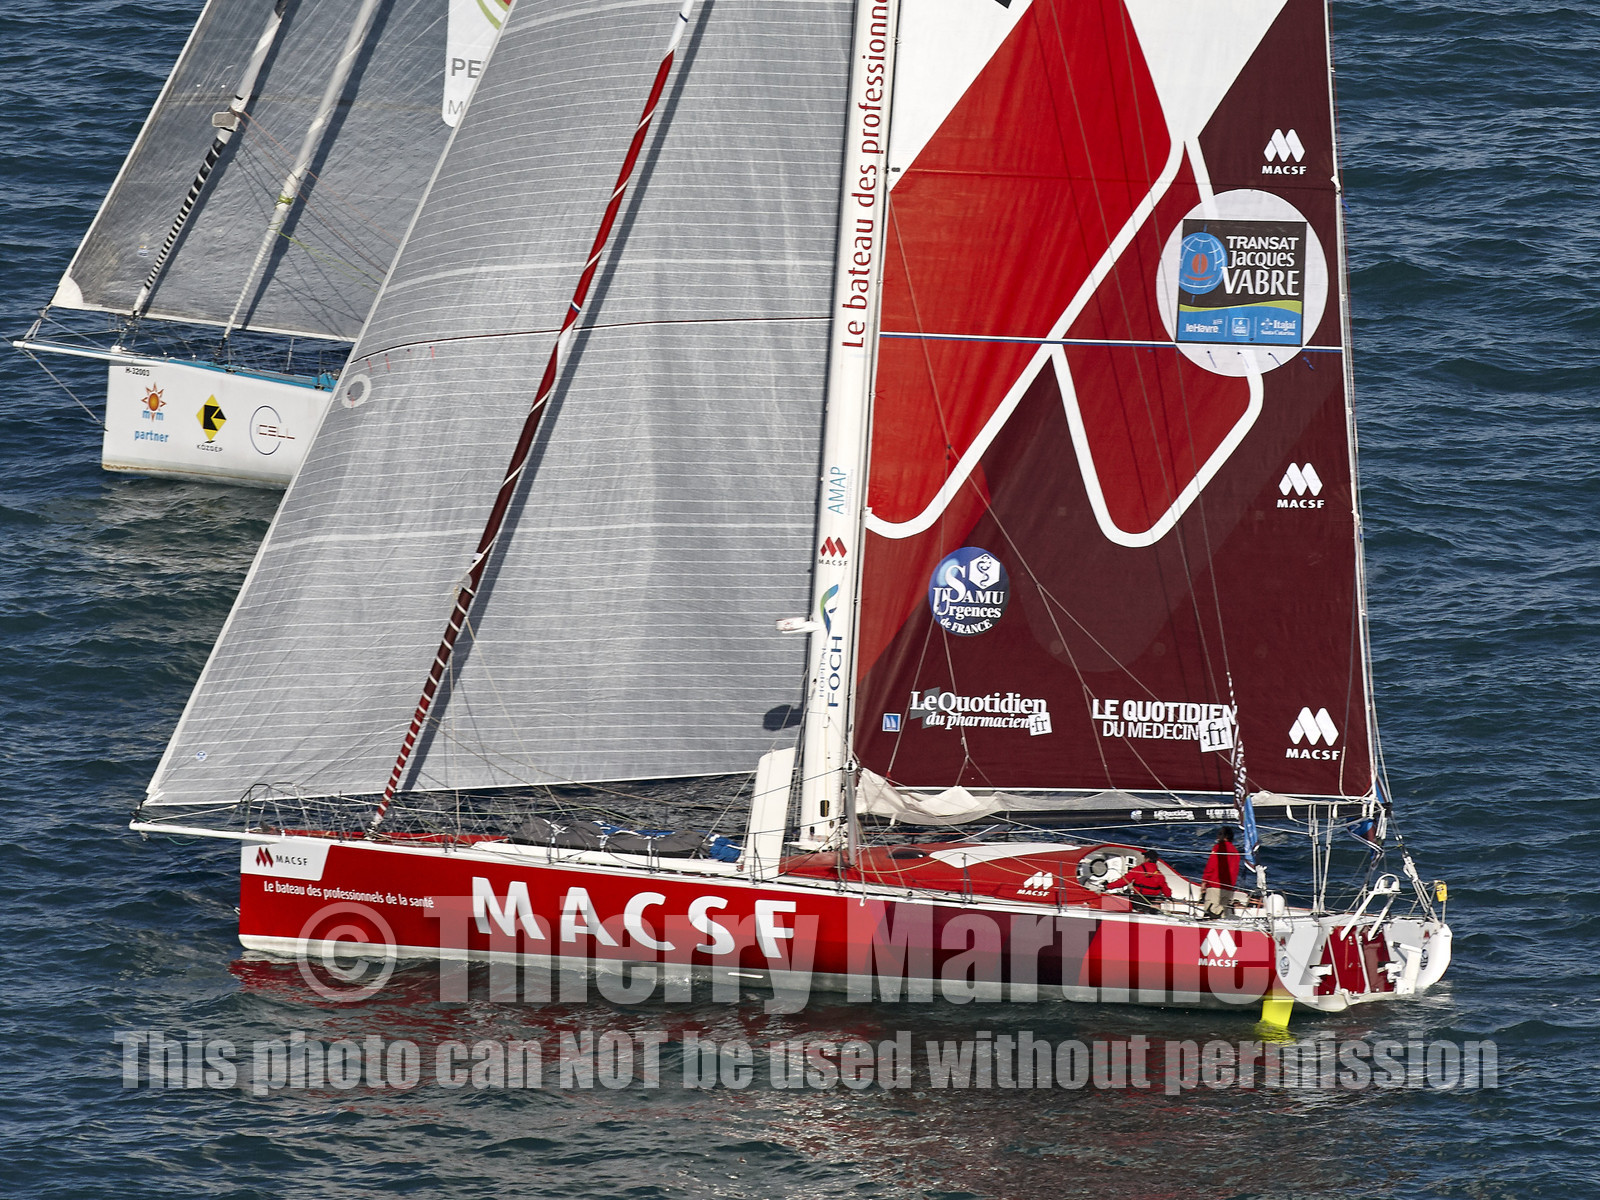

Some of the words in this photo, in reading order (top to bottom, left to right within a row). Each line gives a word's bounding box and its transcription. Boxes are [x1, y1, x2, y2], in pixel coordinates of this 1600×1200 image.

[1261, 165, 1307, 175] MACSF
[851, 164, 877, 207] des
[1226, 235, 1300, 250] TRANSAT
[842, 218, 874, 310] bateau
[1227, 250, 1295, 270] Jacques
[1220, 266, 1300, 296] VABRE
[135, 430, 169, 443] partner
[827, 466, 847, 515] AMAP
[1276, 499, 1325, 509] MACSF
[818, 559, 848, 567] MACSF
[943, 565, 1005, 605] SAMU
[933, 587, 1002, 620] Urgences
[940, 617, 952, 630] de
[950, 619, 993, 634] FRANCE
[828, 635, 843, 708] FOCH
[910, 690, 938, 711] Le
[938, 690, 1047, 715] Quotidien
[1092, 698, 1120, 721] LE
[1122, 699, 1238, 725] QUOTIDIEN
[925, 712, 945, 726] du
[1102, 720, 1125, 738] DU
[1285, 748, 1341, 761] MACSF
[275, 854, 308, 867] MACSF
[263, 880, 274, 892] Le
[275, 880, 306, 896] bateau
[306, 884, 322, 897] des
[323, 887, 385, 904] professionnels
[385, 892, 398, 905] de
[398, 893, 408, 906] la
[409, 896, 435, 909] santé
[1016, 888, 1050, 899] MACSF
[471, 876, 797, 959] MACSF
[1198, 958, 1239, 968] MACSF
